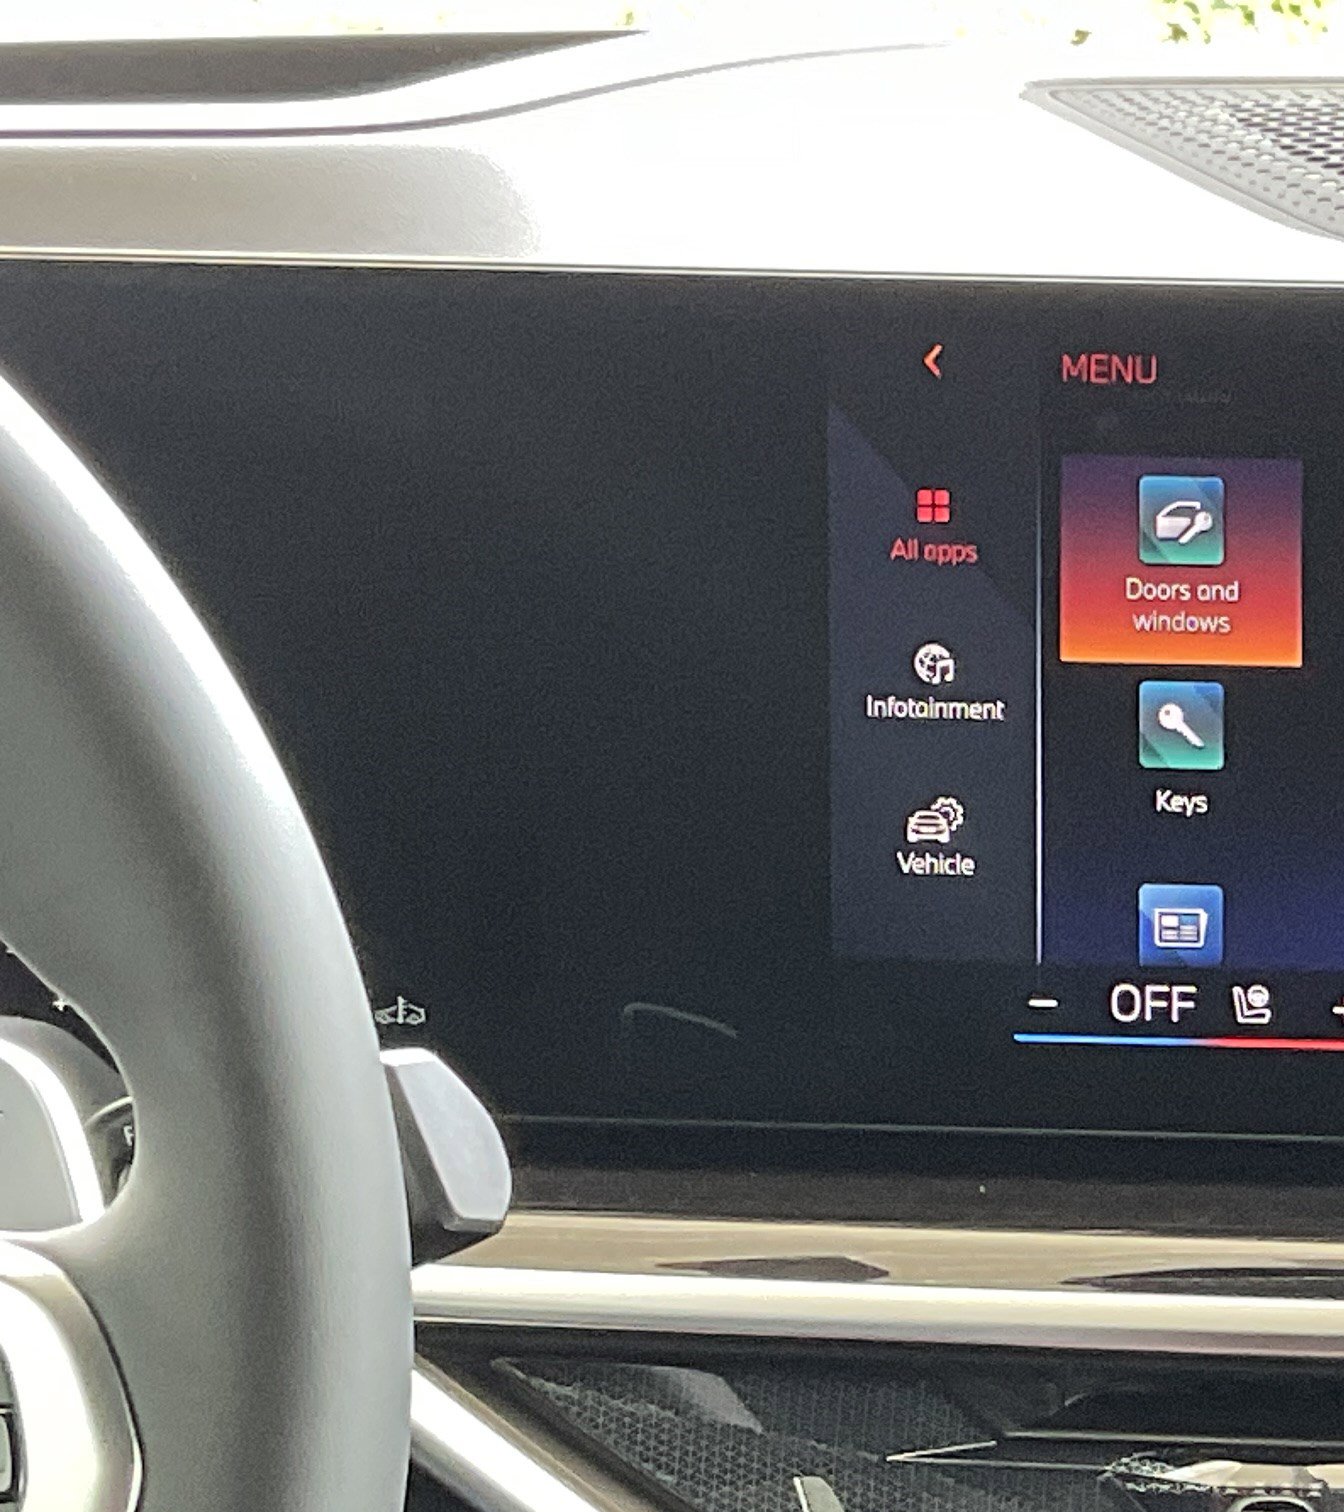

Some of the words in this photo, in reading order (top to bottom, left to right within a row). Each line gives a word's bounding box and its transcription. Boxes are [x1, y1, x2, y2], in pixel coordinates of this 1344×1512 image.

[1060, 353, 1160, 386] MENU
[889, 537, 919, 561] All
[922, 543, 979, 567] apps
[1124, 577, 1191, 601] Doors
[1196, 580, 1240, 602] and
[1132, 611, 1232, 634] windows
[865, 695, 1006, 721] Infotainment
[1154, 789, 1209, 817] Keys
[896, 851, 976, 877] Vehicle
[1110, 983, 1199, 1024] OFF
